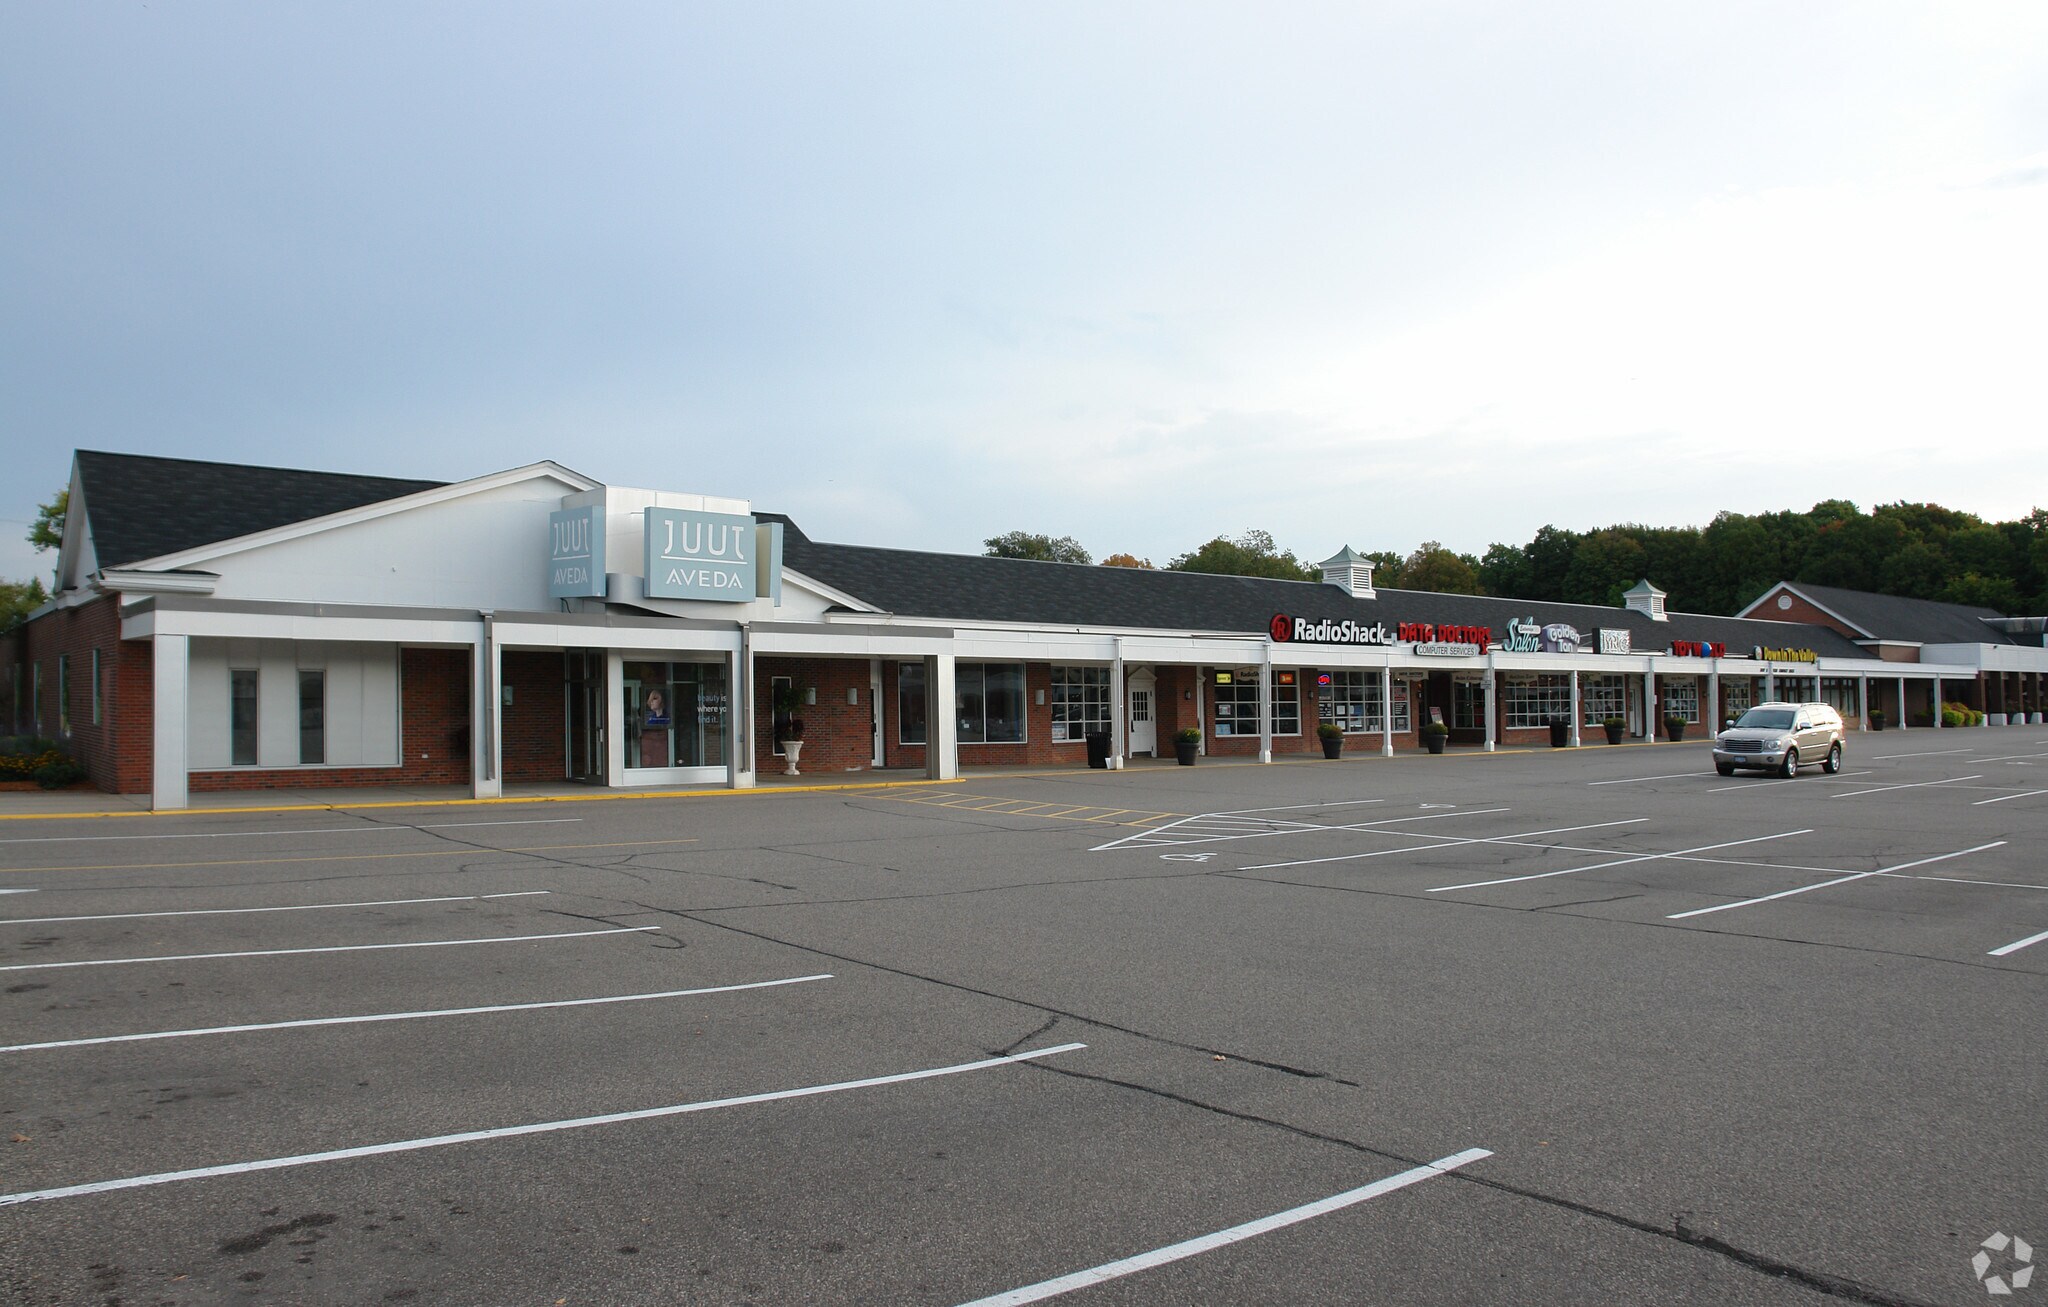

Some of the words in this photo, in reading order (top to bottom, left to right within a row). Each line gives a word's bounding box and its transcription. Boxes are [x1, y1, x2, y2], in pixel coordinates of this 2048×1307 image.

[554, 518, 589, 554] JUUT
[664, 519, 745, 560] JUUT
[554, 567, 588, 585] AVEDA
[666, 568, 744, 589] AVEDA
[1294, 617, 1386, 643] RadioShack
[1398, 622, 1433, 643] DATA
[1437, 624, 1492, 655] DOCTORS
[1503, 616, 1539, 652] Salon
[1549, 625, 1580, 644] Golden
[1419, 646, 1448, 655] COMPUTER
[1450, 647, 1475, 656] SERVICES
[1558, 640, 1573, 652] Tan
[1673, 640, 1692, 657] TOY
[697, 694, 719, 703] beauty
[720, 694, 727, 702] is
[719, 707, 727, 715] yo
